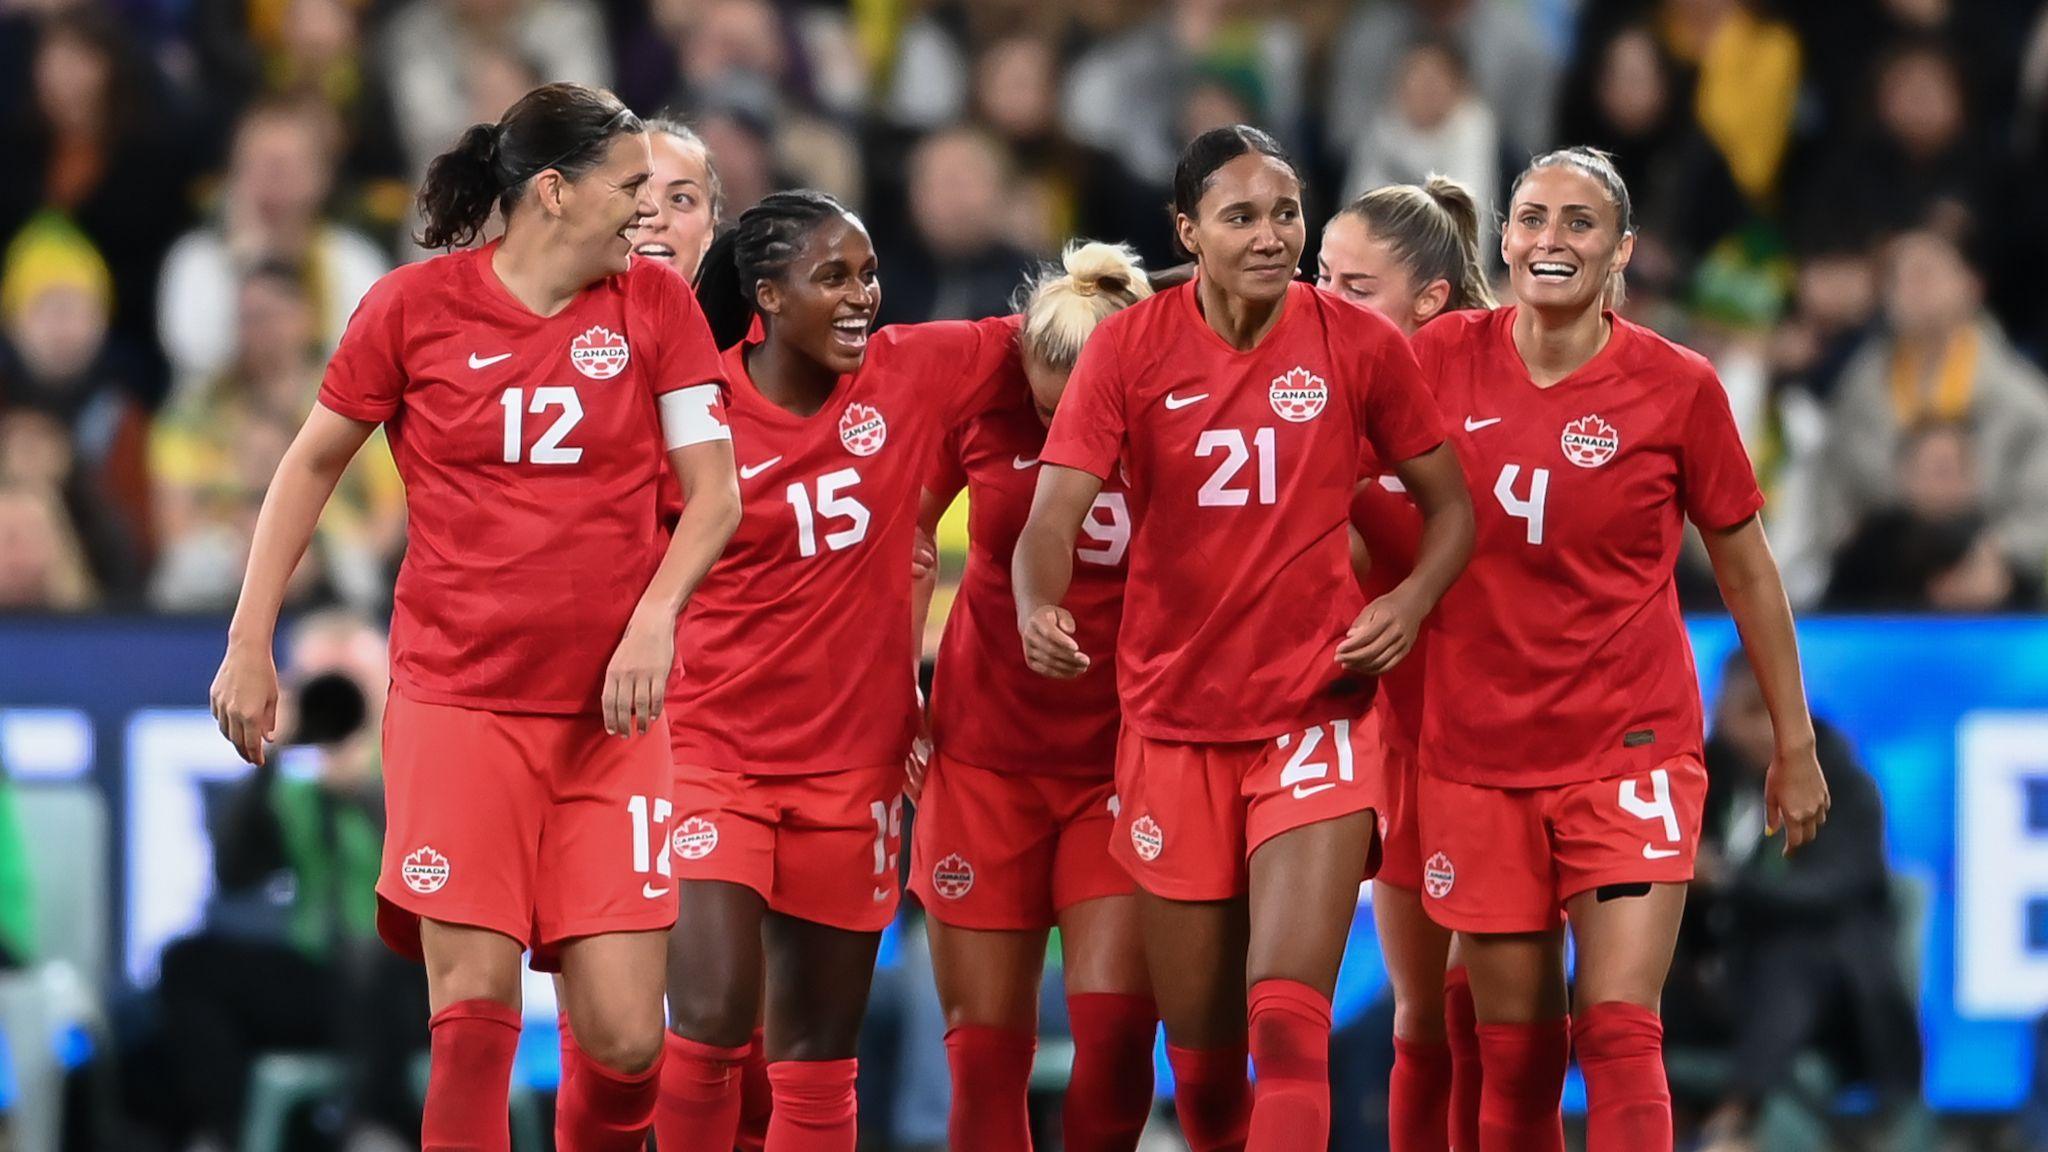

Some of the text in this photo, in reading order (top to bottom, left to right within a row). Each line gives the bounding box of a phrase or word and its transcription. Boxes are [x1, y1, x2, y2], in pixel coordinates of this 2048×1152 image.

[573, 348, 627, 358] CANADA
[1271, 391, 1325, 399] CANADA
[499, 387, 585, 465] 12
[842, 419, 882, 440] CANADA
[1563, 434, 1616, 449] CANADA
[1194, 427, 1277, 506] 21
[786, 467, 871, 558] 15
[1493, 463, 1550, 545] 4
[1275, 718, 1354, 787] 21
[1617, 768, 1681, 842] 4
[674, 833, 715, 846] CANADA
[1132, 831, 1160, 846] CANADA
[404, 866, 446, 875] CANADA
